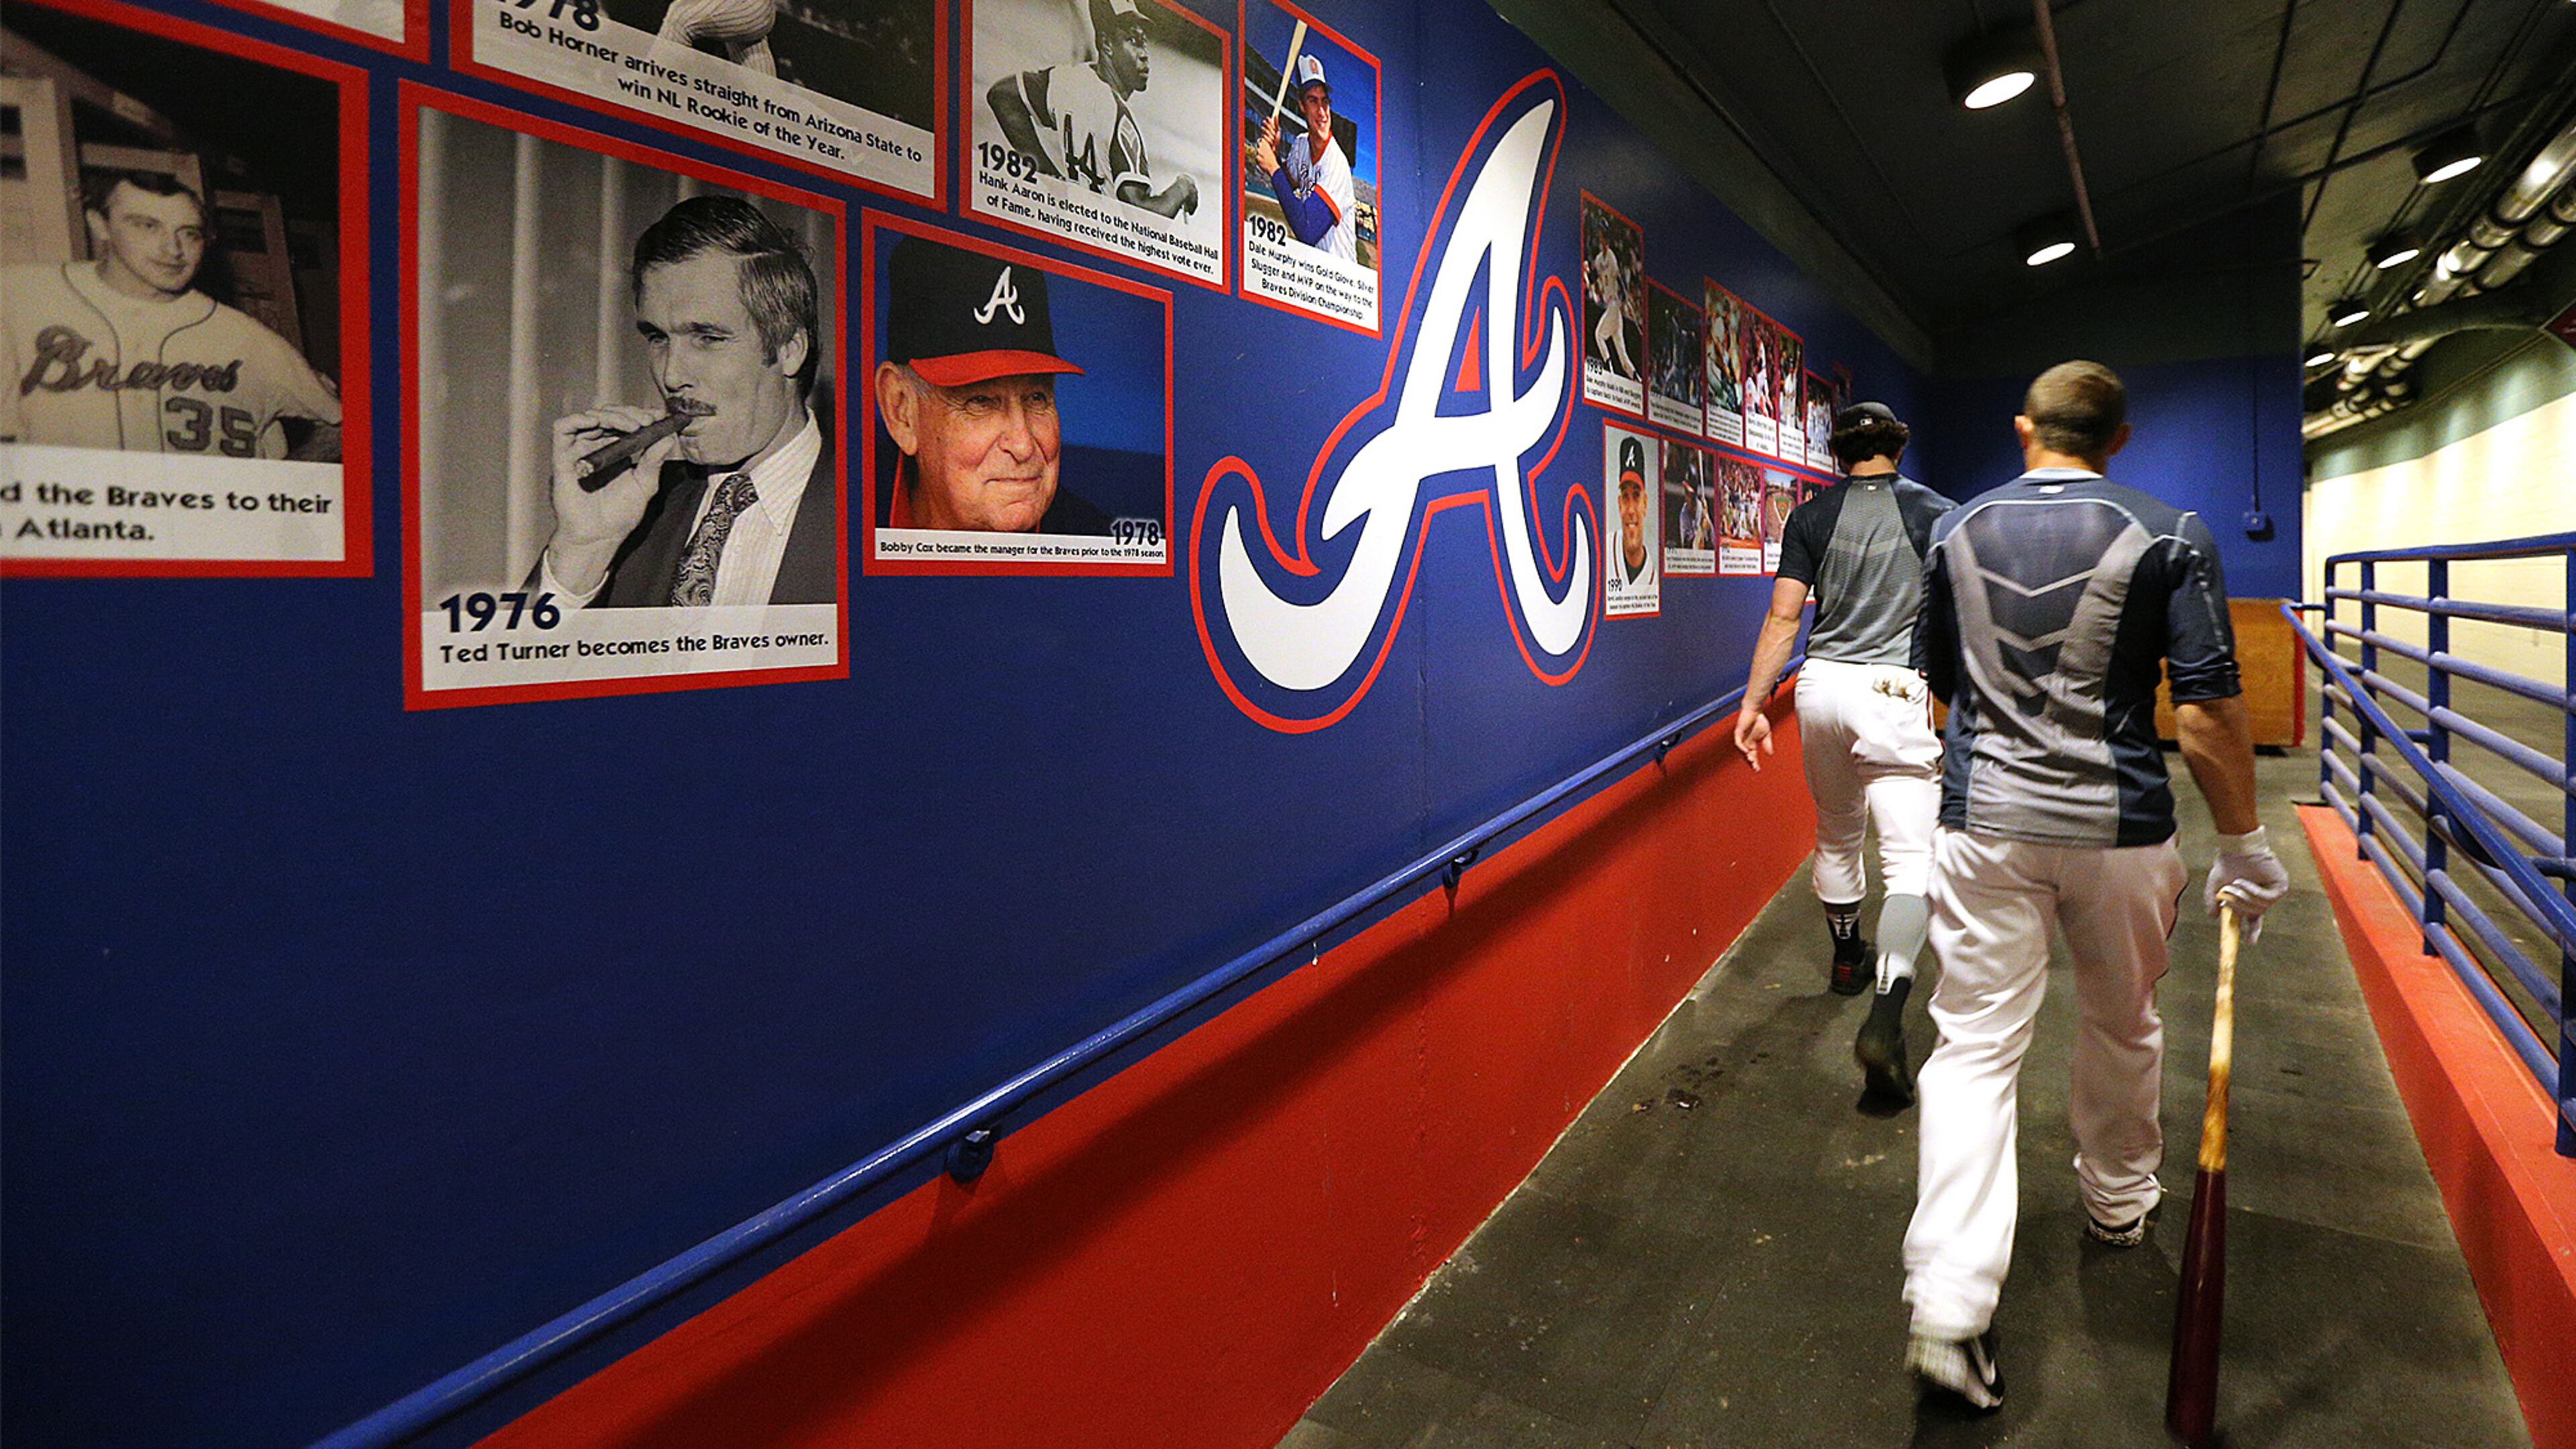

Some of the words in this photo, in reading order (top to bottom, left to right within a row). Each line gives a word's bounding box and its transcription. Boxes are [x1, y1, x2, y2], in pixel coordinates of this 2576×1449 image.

[500, 11, 542, 38] Bob
[549, 27, 619, 64] Horner
[625, 55, 688, 87] arrives
[694, 78, 759, 110] straight
[763, 99, 800, 123] from
[804, 114, 862, 144] Arizona
[866, 133, 902, 156] State
[906, 147, 922, 162] to
[617, 78, 651, 100] win
[657, 88, 682, 109] NL
[687, 97, 748, 129] Rookie
[753, 121, 771, 136] of
[775, 125, 802, 146] the
[806, 134, 845, 160] Year.
[978, 141, 1038, 184] 1982
[1063, 113, 1105, 195] 44
[979, 170, 1008, 192] Hank
[1012, 183, 1045, 203] Aaron
[1047, 193, 1056, 207] is
[1058, 199, 1098, 221] elected
[1100, 211, 1112, 225] to
[1113, 216, 1129, 231] the
[1131, 221, 1167, 243] National
[1169, 234, 1202, 255] Baseball
[1203, 246, 1218, 260] Hall
[986, 195, 999, 207] of
[1038, 209, 1072, 233] having
[1074, 223, 1118, 244] received
[1120, 235, 1136, 250] the
[1138, 240, 1170, 260] highest
[1171, 254, 1191, 268] vote
[1193, 261, 1214, 274] ever.
[1249, 215, 1286, 246] 1982
[973, 266, 1025, 325] A
[1216, 96, 1593, 692] A
[164, 396, 256, 459] 35
[37, 484, 93, 505] the
[107, 486, 215, 510] Braves
[226, 492, 259, 511] to
[268, 493, 332, 513] their
[16, 519, 154, 541] Atlanta.
[880, 541, 914, 554] Bobby
[916, 542, 934, 553] Cox
[936, 543, 972, 553] became
[973, 544, 988, 553] the
[990, 546, 1025, 557] manager
[1026, 545, 1038, 555] for
[1040, 546, 1053, 555] the
[1055, 546, 1080, 556] Braves
[1081, 547, 1099, 557] prior
[1101, 548, 1110, 556] to
[1110, 548, 1122, 557] the
[1124, 548, 1140, 557] 1978
[1112, 520, 1161, 546] 1978
[440, 592, 561, 633] 1976
[439, 643, 488, 663] Ted
[496, 643, 570, 661] Turner
[577, 640, 670, 657] becomes
[676, 635, 706, 652] the
[712, 635, 769, 650] Braves
[775, 633, 828, 647] owner.
